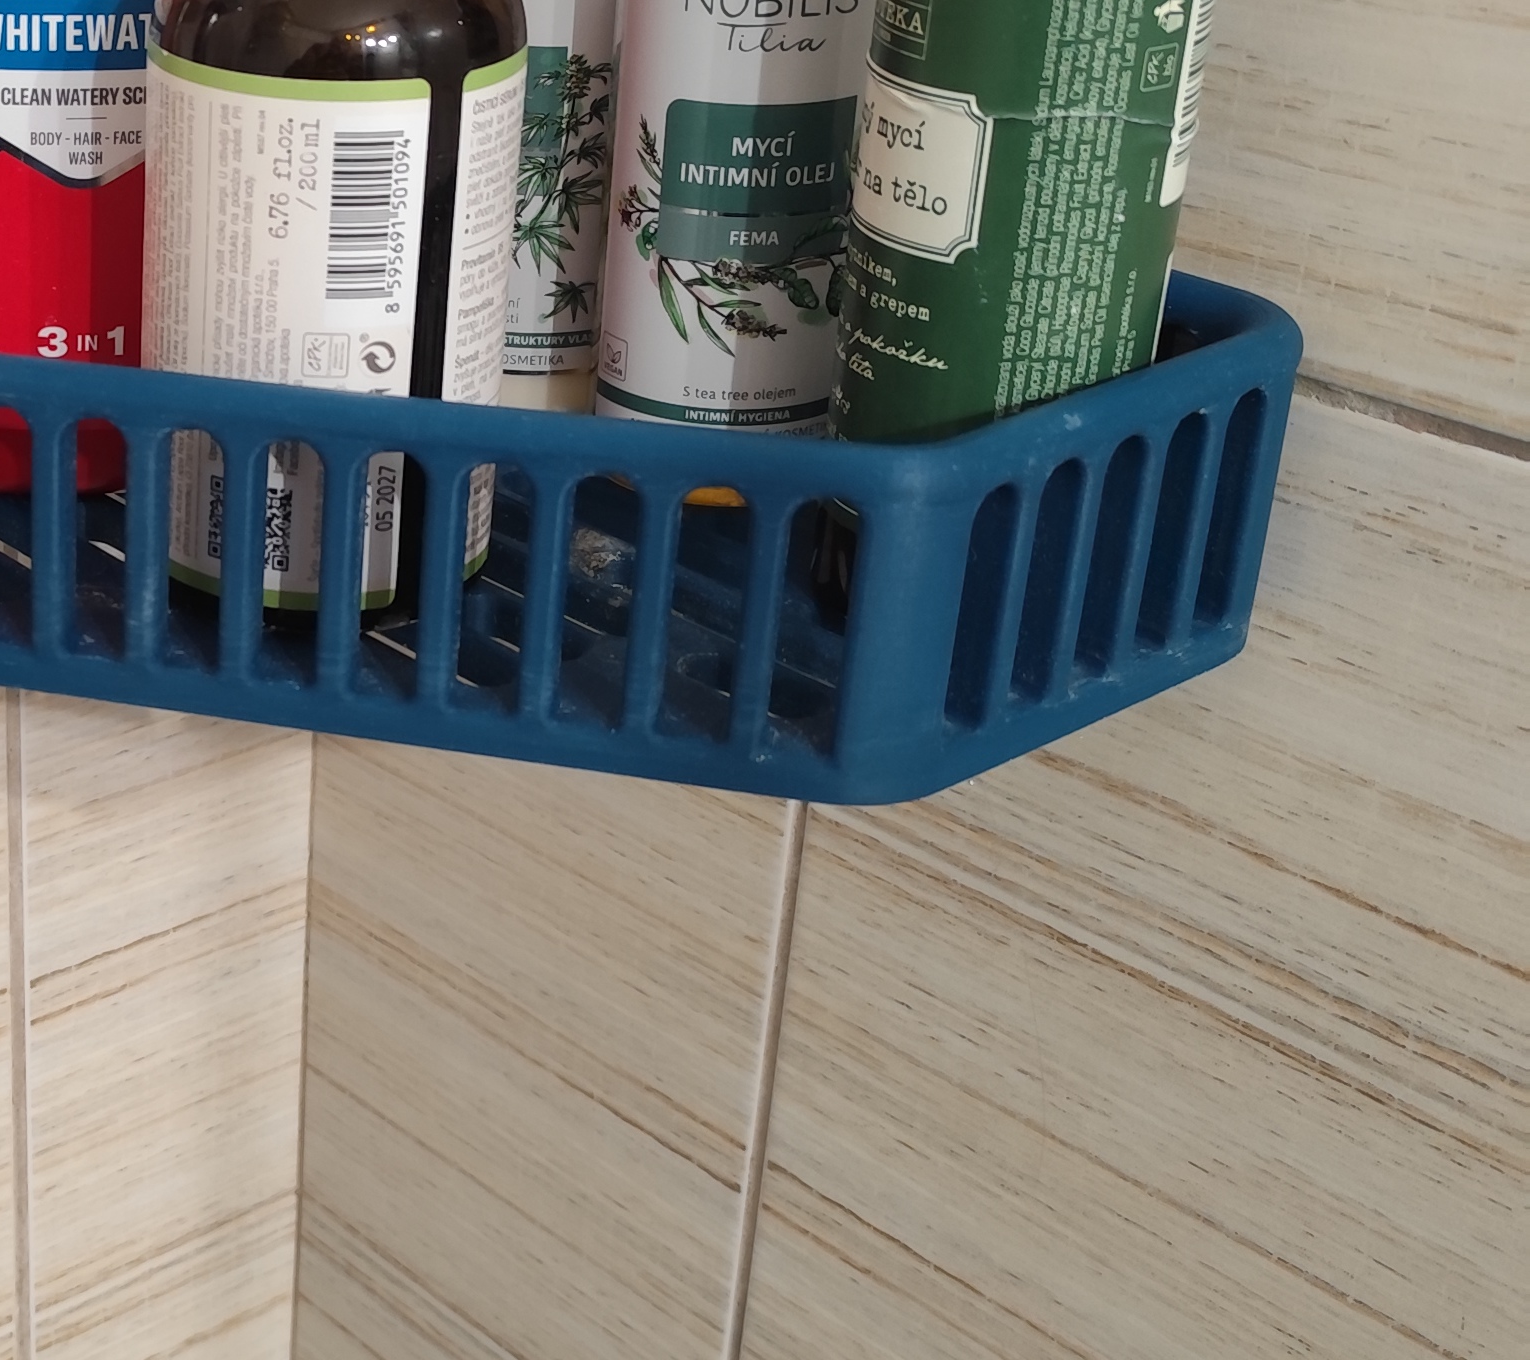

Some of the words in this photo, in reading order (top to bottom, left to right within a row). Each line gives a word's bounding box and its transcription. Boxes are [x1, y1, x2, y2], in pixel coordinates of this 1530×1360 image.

[716, 21, 828, 52] Tilia
[0, 87, 52, 106] CLEAN
[56, 87, 118, 106] WATERY
[30, 131, 62, 146] BODY
[73, 131, 102, 146] HAIR
[113, 130, 142, 145] FACE
[731, 130, 796, 158] MYCÍ
[876, 115, 926, 151] mycí
[68, 151, 104, 166] WASH
[679, 161, 780, 188] INTIMNÍ
[785, 161, 836, 186] OLEJ
[863, 167, 883, 197] na
[890, 176, 948, 216] tělo
[268, 192, 291, 240] 6.76
[729, 230, 780, 246] FEMA
[869, 291, 930, 322] grepem
[36, 325, 69, 358] 3
[76, 334, 99, 352] IN
[106, 325, 125, 356] 1
[502, 353, 565, 367] OSMETIKA
[683, 386, 691, 398] S
[695, 388, 716, 401] tea
[721, 389, 749, 401] tree
[753, 386, 797, 403] olejem
[684, 408, 736, 423] INTIMNÍ
[738, 409, 791, 423] HYGIENA
[376, 465, 395, 505] 2027
[374, 510, 393, 532] 05
